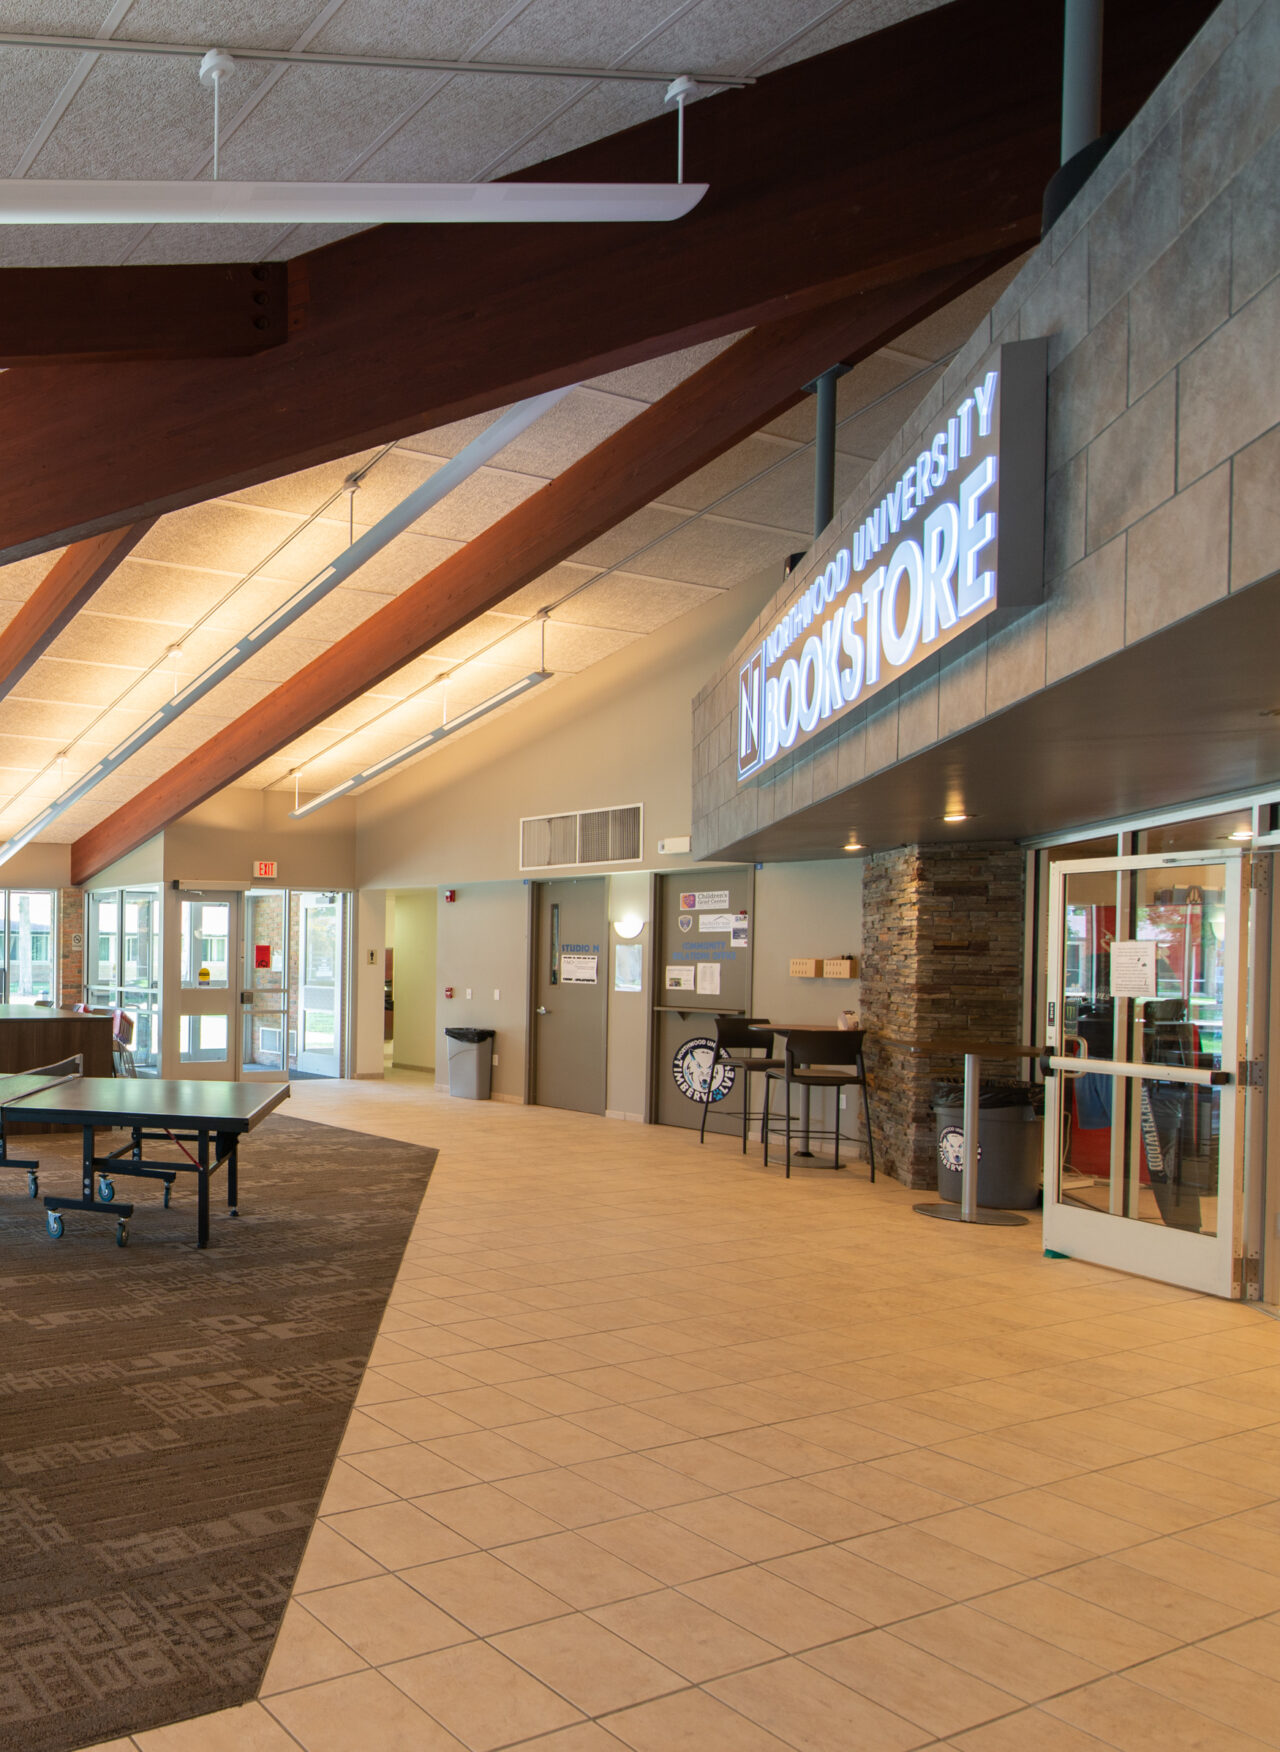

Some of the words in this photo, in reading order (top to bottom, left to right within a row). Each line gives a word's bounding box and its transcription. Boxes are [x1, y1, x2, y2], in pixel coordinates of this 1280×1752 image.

[766, 548, 851, 667] NORTHWOOD
[852, 371, 998, 571] UNIVERSITY
[765, 456, 996, 760] BOOKSTORE
[259, 862, 275, 876] EXIT
[562, 944, 590, 952] STUDIO
[682, 941, 726, 950] COMMUNITY
